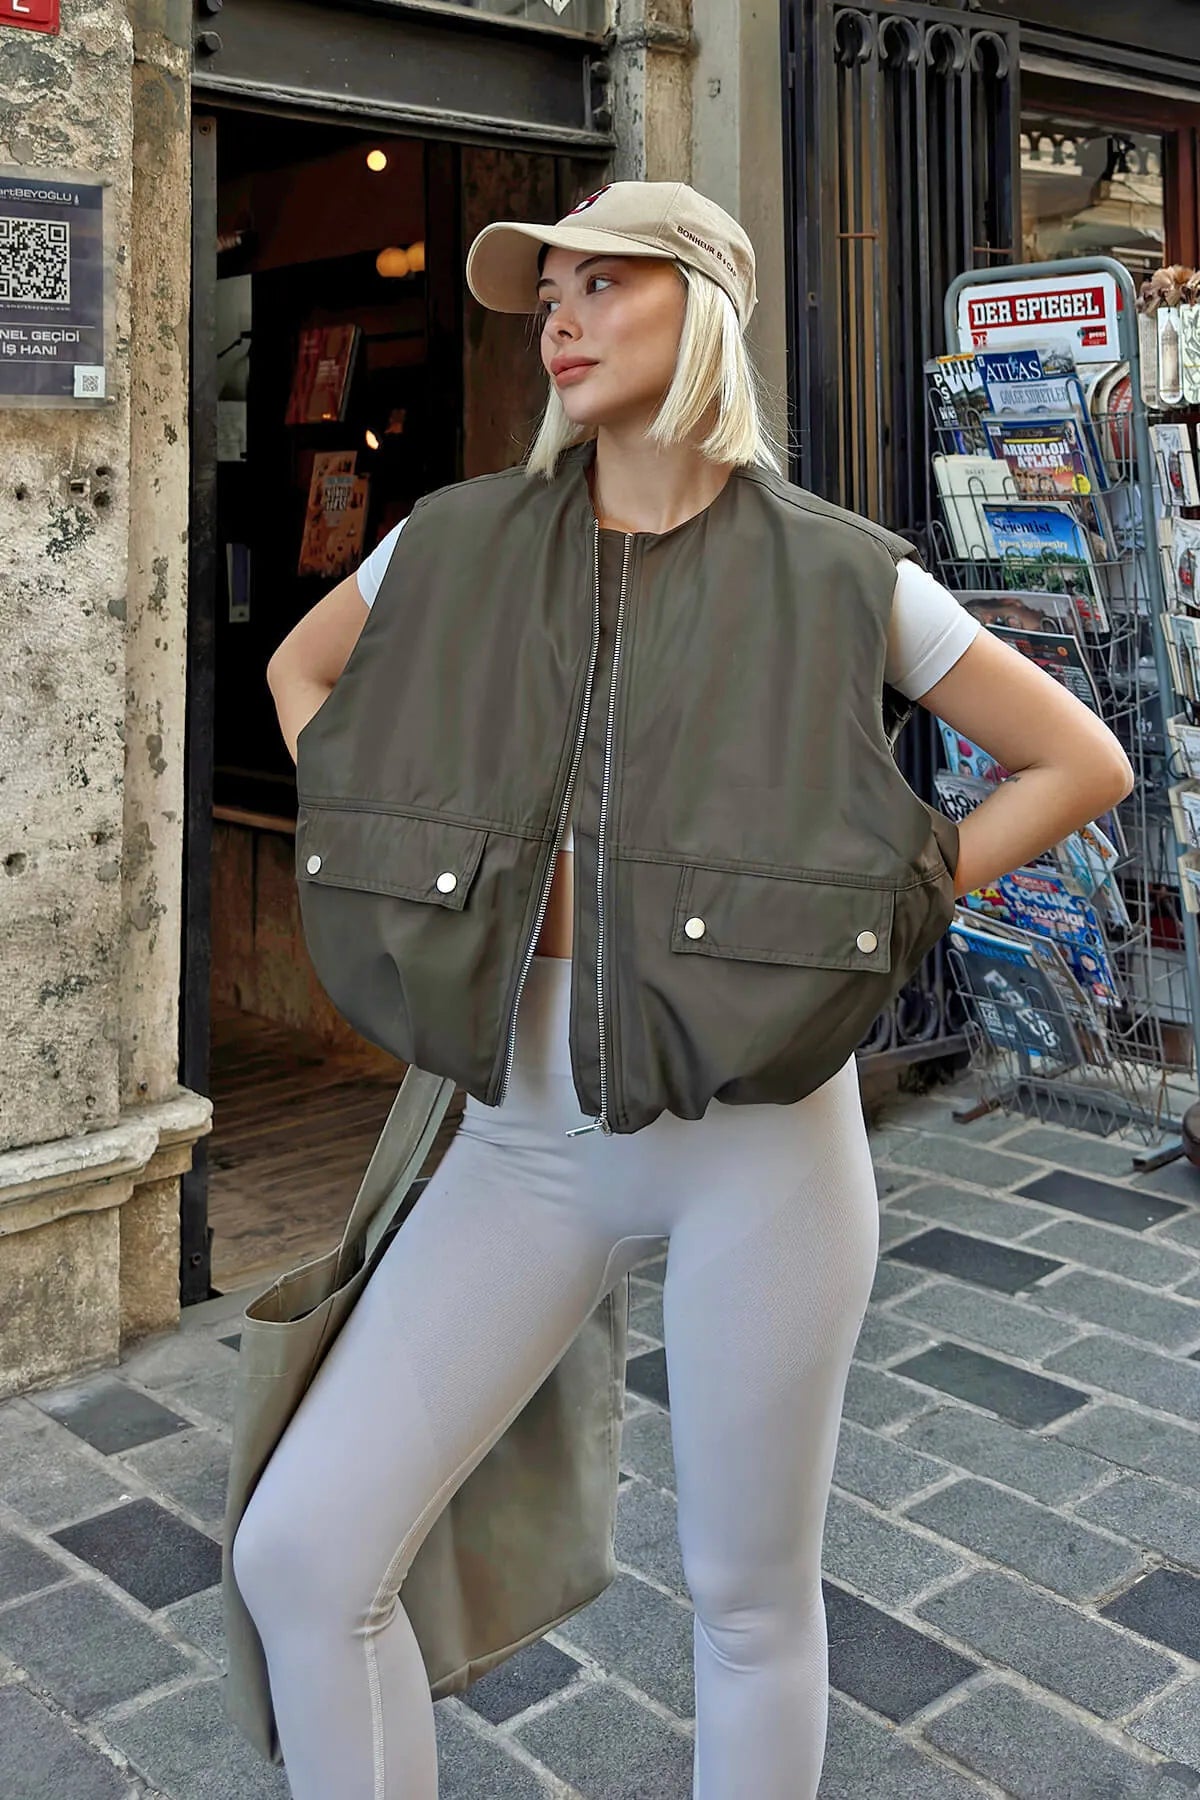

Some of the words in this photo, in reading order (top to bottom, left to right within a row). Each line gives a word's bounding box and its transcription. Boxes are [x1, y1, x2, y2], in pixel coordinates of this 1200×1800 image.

[677, 225, 716, 255] BONHEUR
[972, 301, 1013, 326] DER
[1015, 292, 1100, 321] SPIEGEL
[31, 329, 80, 344] GEÇİDİ
[2, 341, 17, 357] İŞ
[20, 344, 58, 356] HANI
[986, 360, 1042, 382] ATLAS
[1017, 454, 1065, 469] ATLASI
[991, 519, 1053, 534] Scientist
